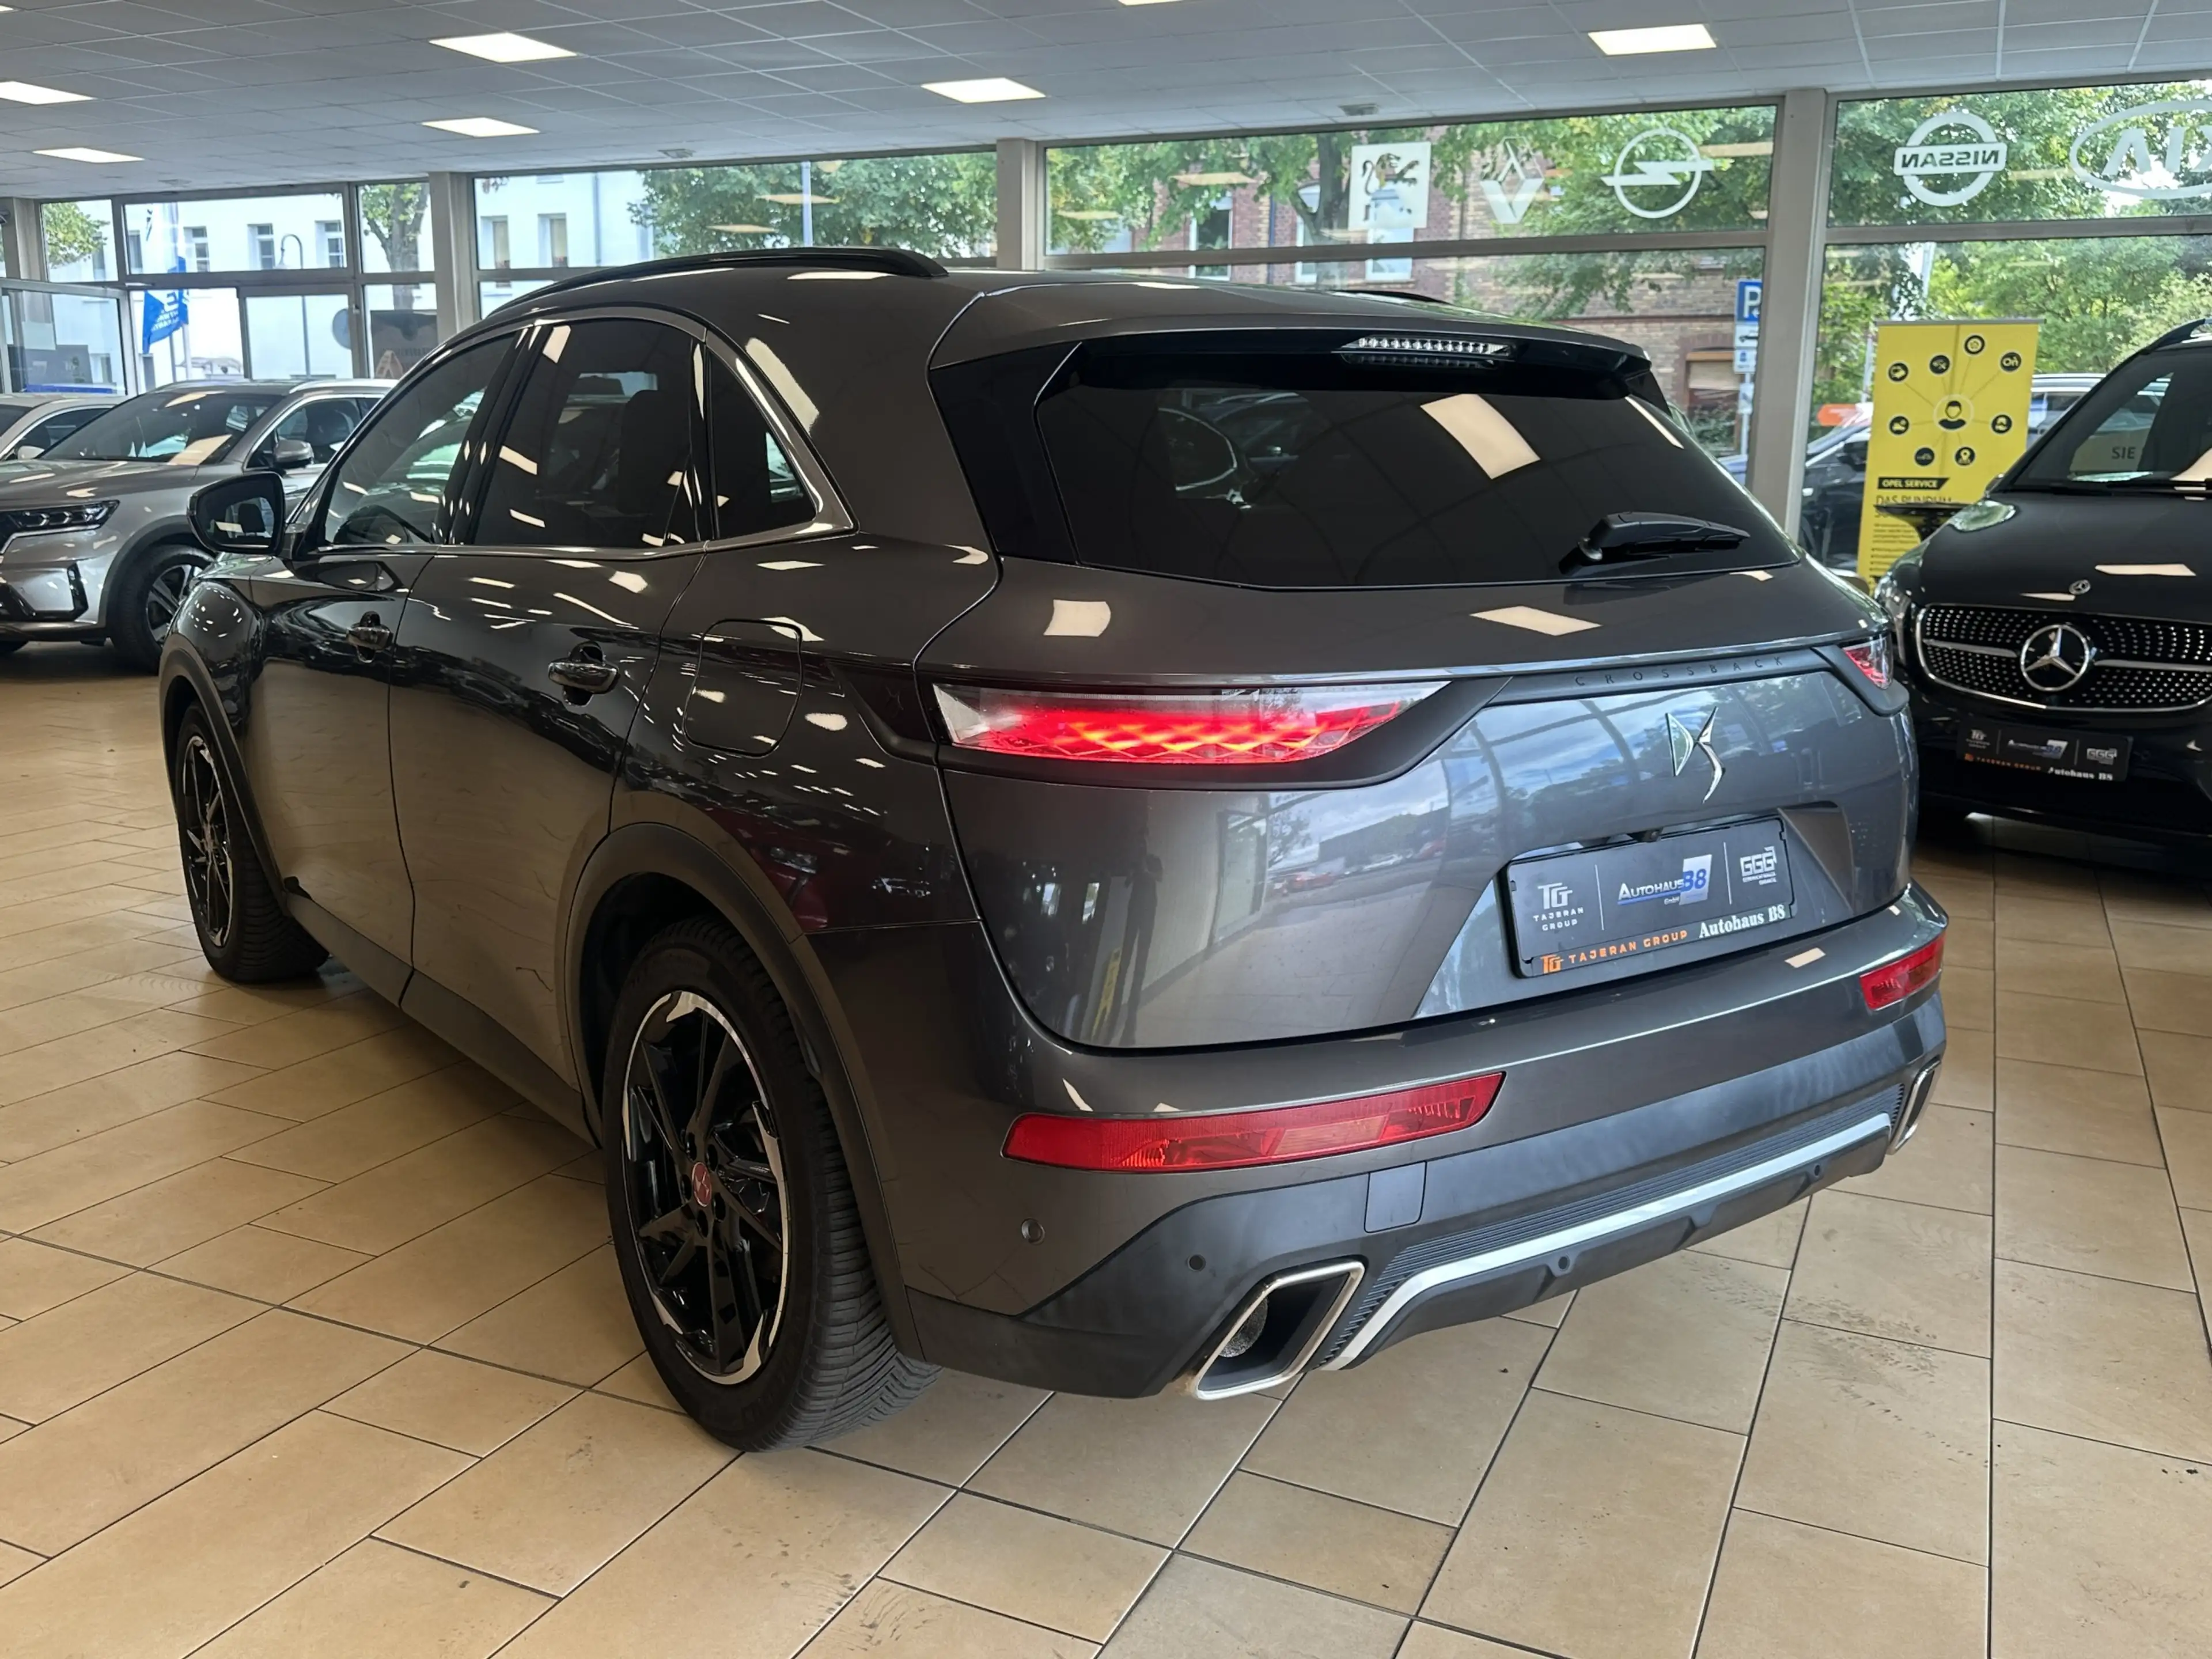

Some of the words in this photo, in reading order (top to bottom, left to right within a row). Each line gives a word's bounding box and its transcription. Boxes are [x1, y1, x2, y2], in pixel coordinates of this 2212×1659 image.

[1744, 285, 1762, 318] P
[1882, 479, 1902, 487] OPEL
[1904, 479, 1938, 488] SERVICE
[1575, 657, 1783, 686] CROSSBACK
[1681, 869, 1707, 892] B8
[1533, 907, 1584, 922] TAJERAN
[1542, 919, 1578, 931] GROUP
[1699, 913, 1765, 938] Autohaus
[1768, 904, 1786, 922] B8
[1569, 941, 1637, 964] TAJERAN
[1643, 930, 1688, 948] GROUP
